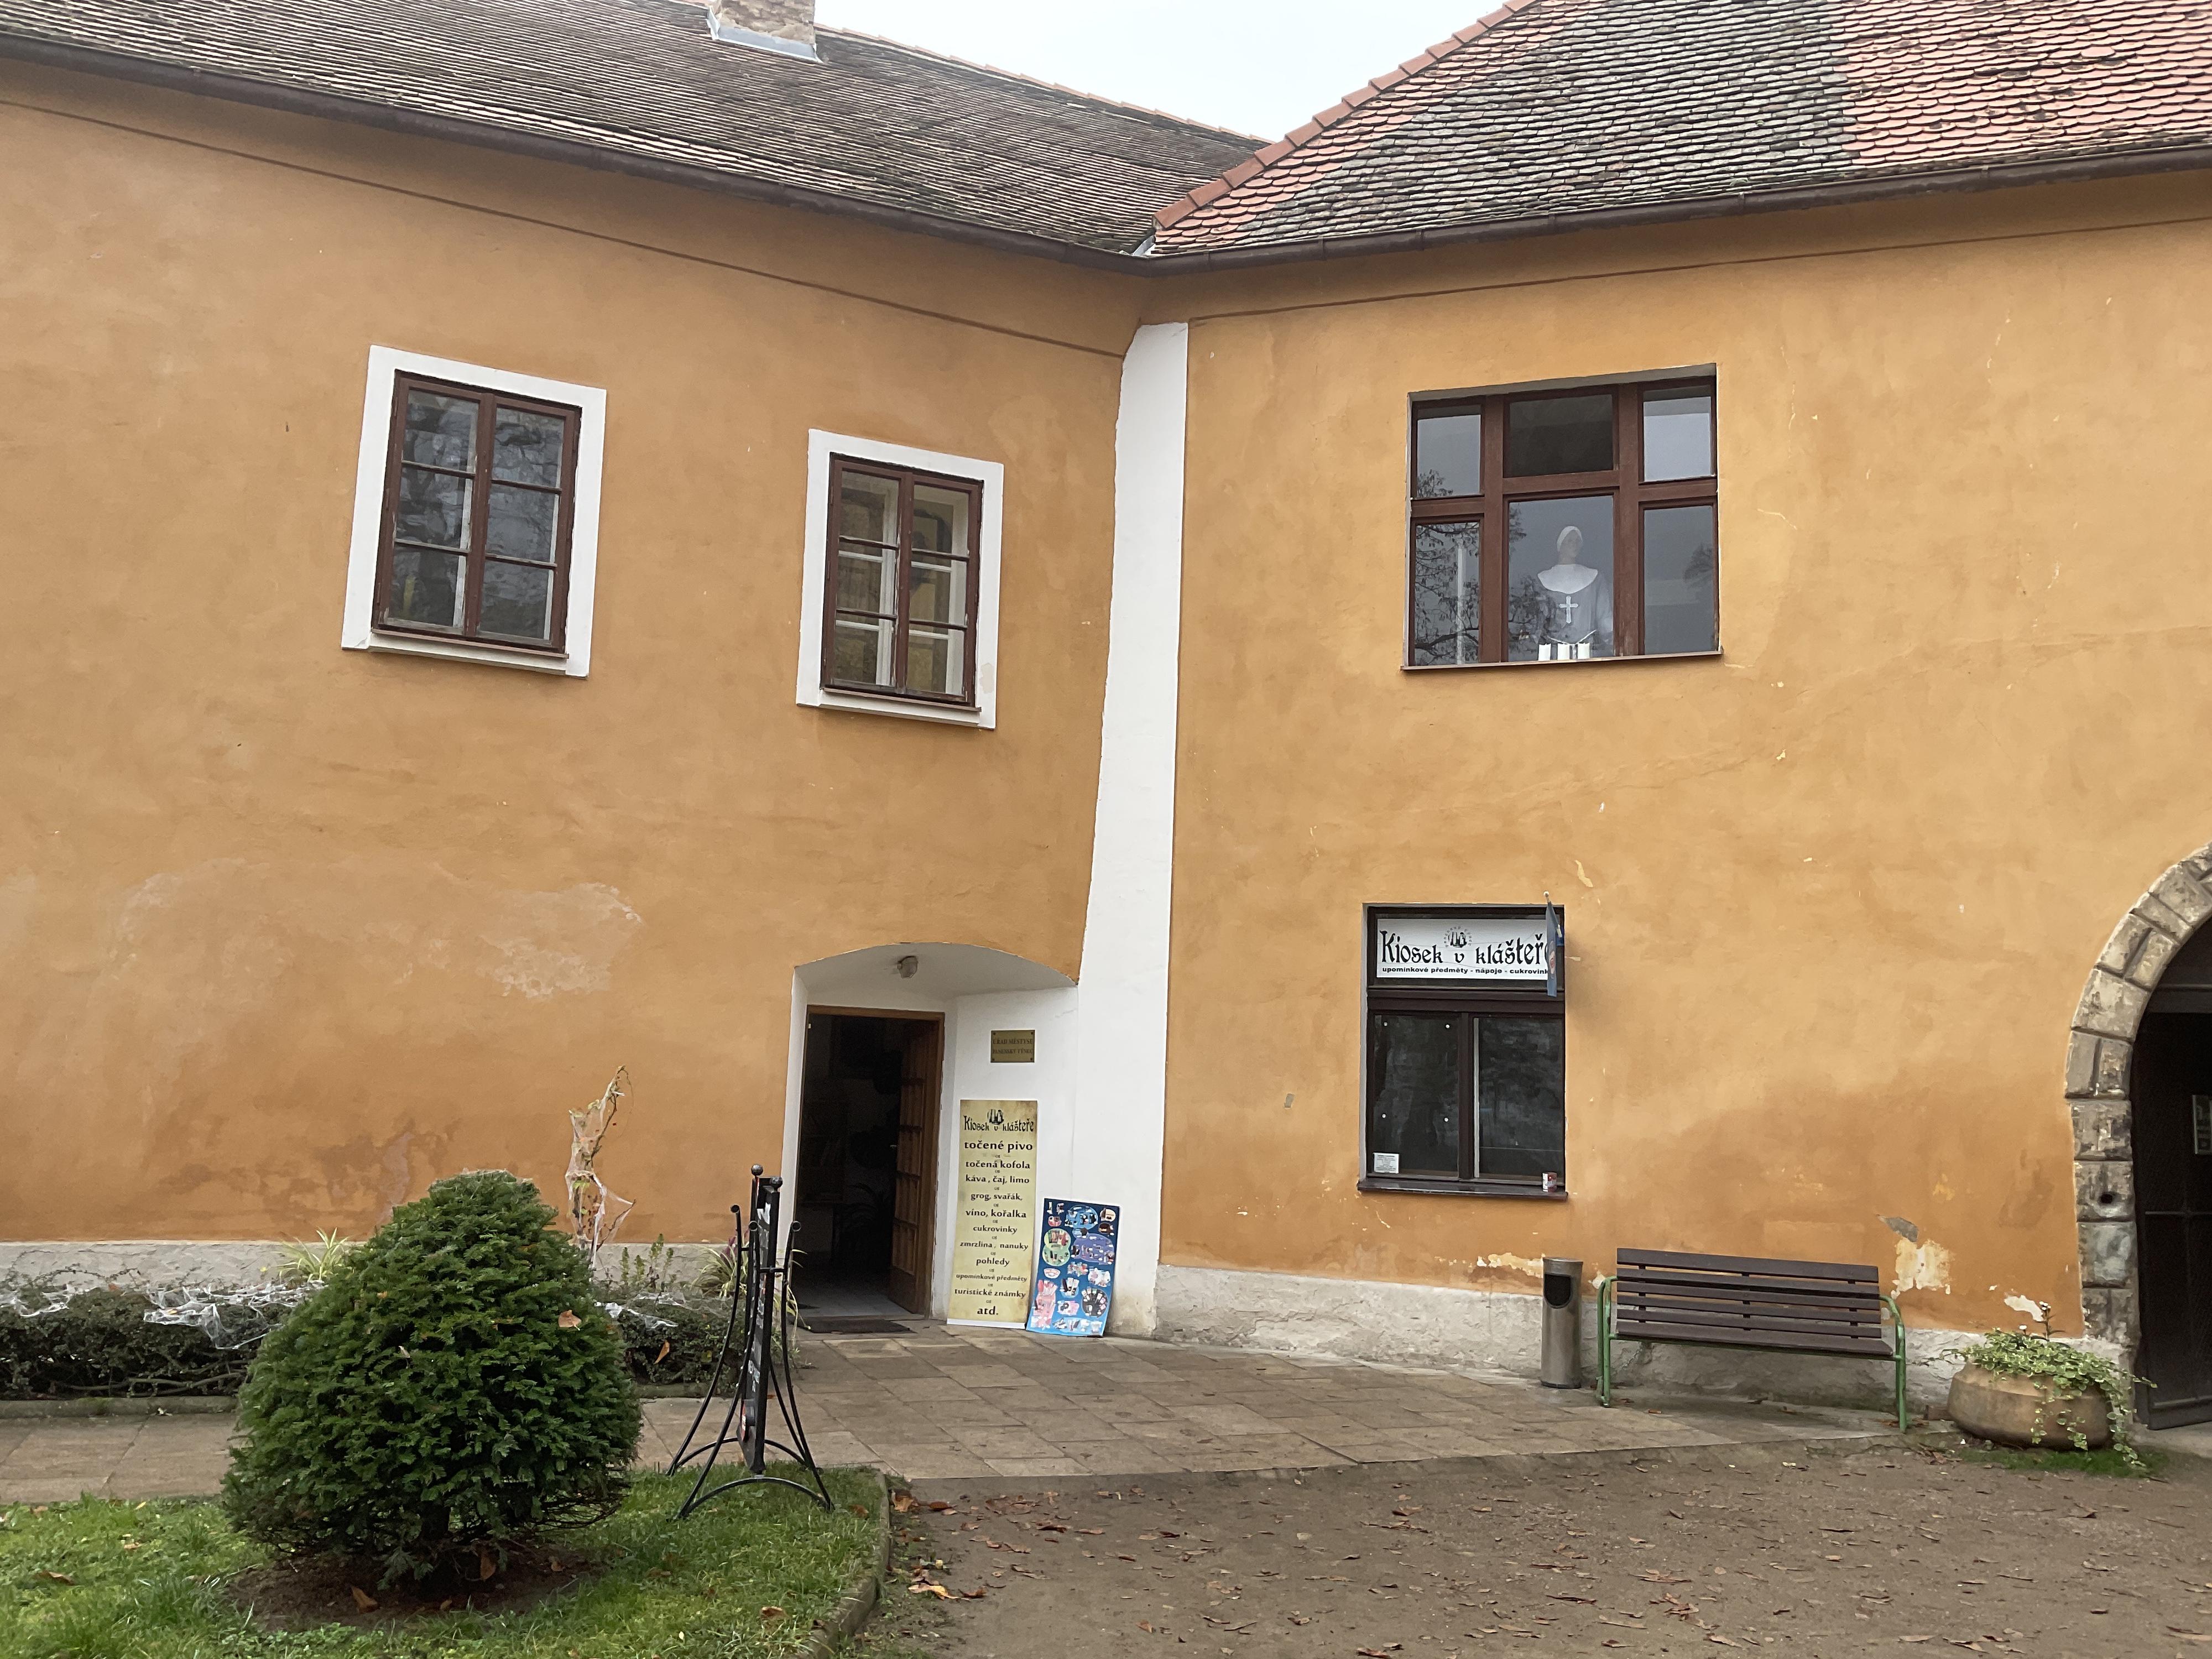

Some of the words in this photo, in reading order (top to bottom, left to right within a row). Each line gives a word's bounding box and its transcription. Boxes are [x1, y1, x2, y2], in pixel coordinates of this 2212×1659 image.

[1380, 930, 1443, 963] Kiosek
[1454, 952, 1464, 963] v
[963, 1115, 989, 1131] Kiosek
[1003, 1118, 1034, 1132] klášteře
[964, 1140, 1004, 1150] točené
[1008, 1141, 1033, 1153] pivo
[1000, 1161, 1030, 1169] kofola
[993, 1176, 1008, 1185] čaj,
[991, 1209, 1026, 1218] kořalka
[973, 1225, 1018, 1234] cukrovinky
[1000, 1243, 1029, 1251] nanuky
[976, 1258, 1010, 1267] pohledy
[994, 1290, 1026, 1299] známky
[977, 1306, 999, 1315] atd.
